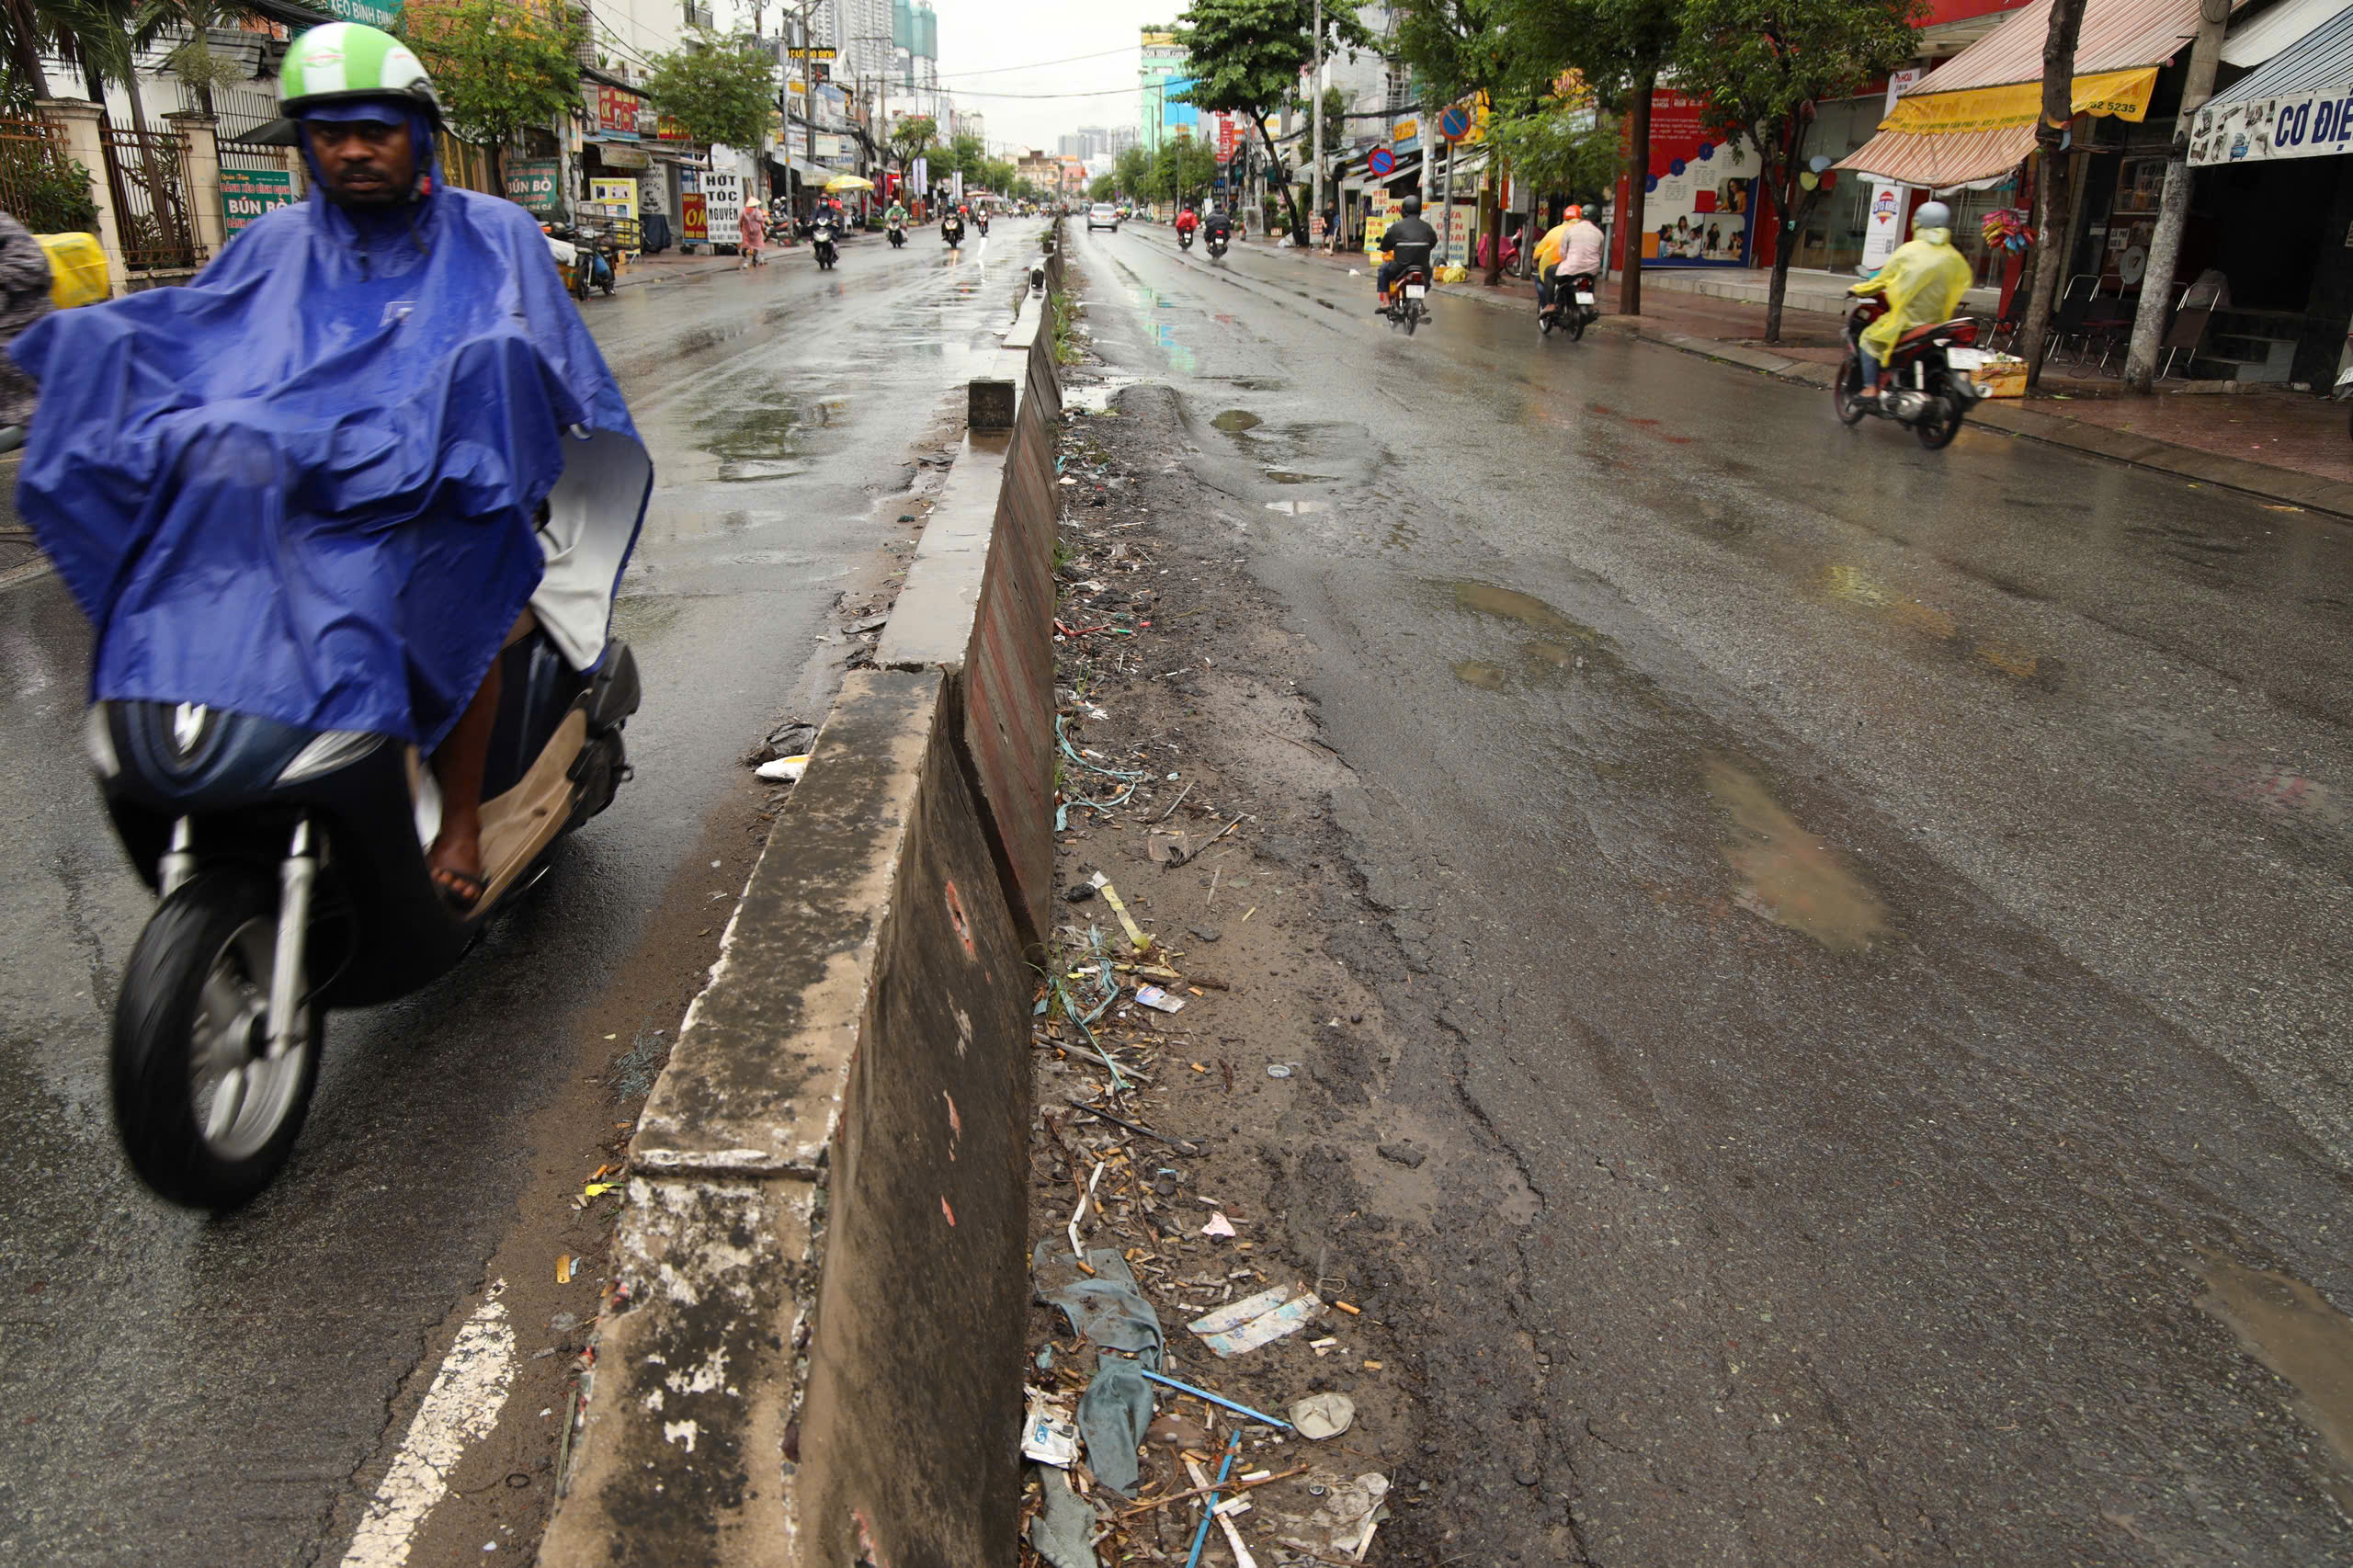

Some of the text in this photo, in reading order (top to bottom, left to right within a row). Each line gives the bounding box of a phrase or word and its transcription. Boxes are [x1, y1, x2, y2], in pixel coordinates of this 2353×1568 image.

[2107, 102, 2136, 113] 5235
[2274, 87, 2353, 152] CƠ ĐIỆ
[533, 176, 552, 192] BÒ
[707, 189, 737, 201] TÓC
[228, 196, 263, 214] BÚN
